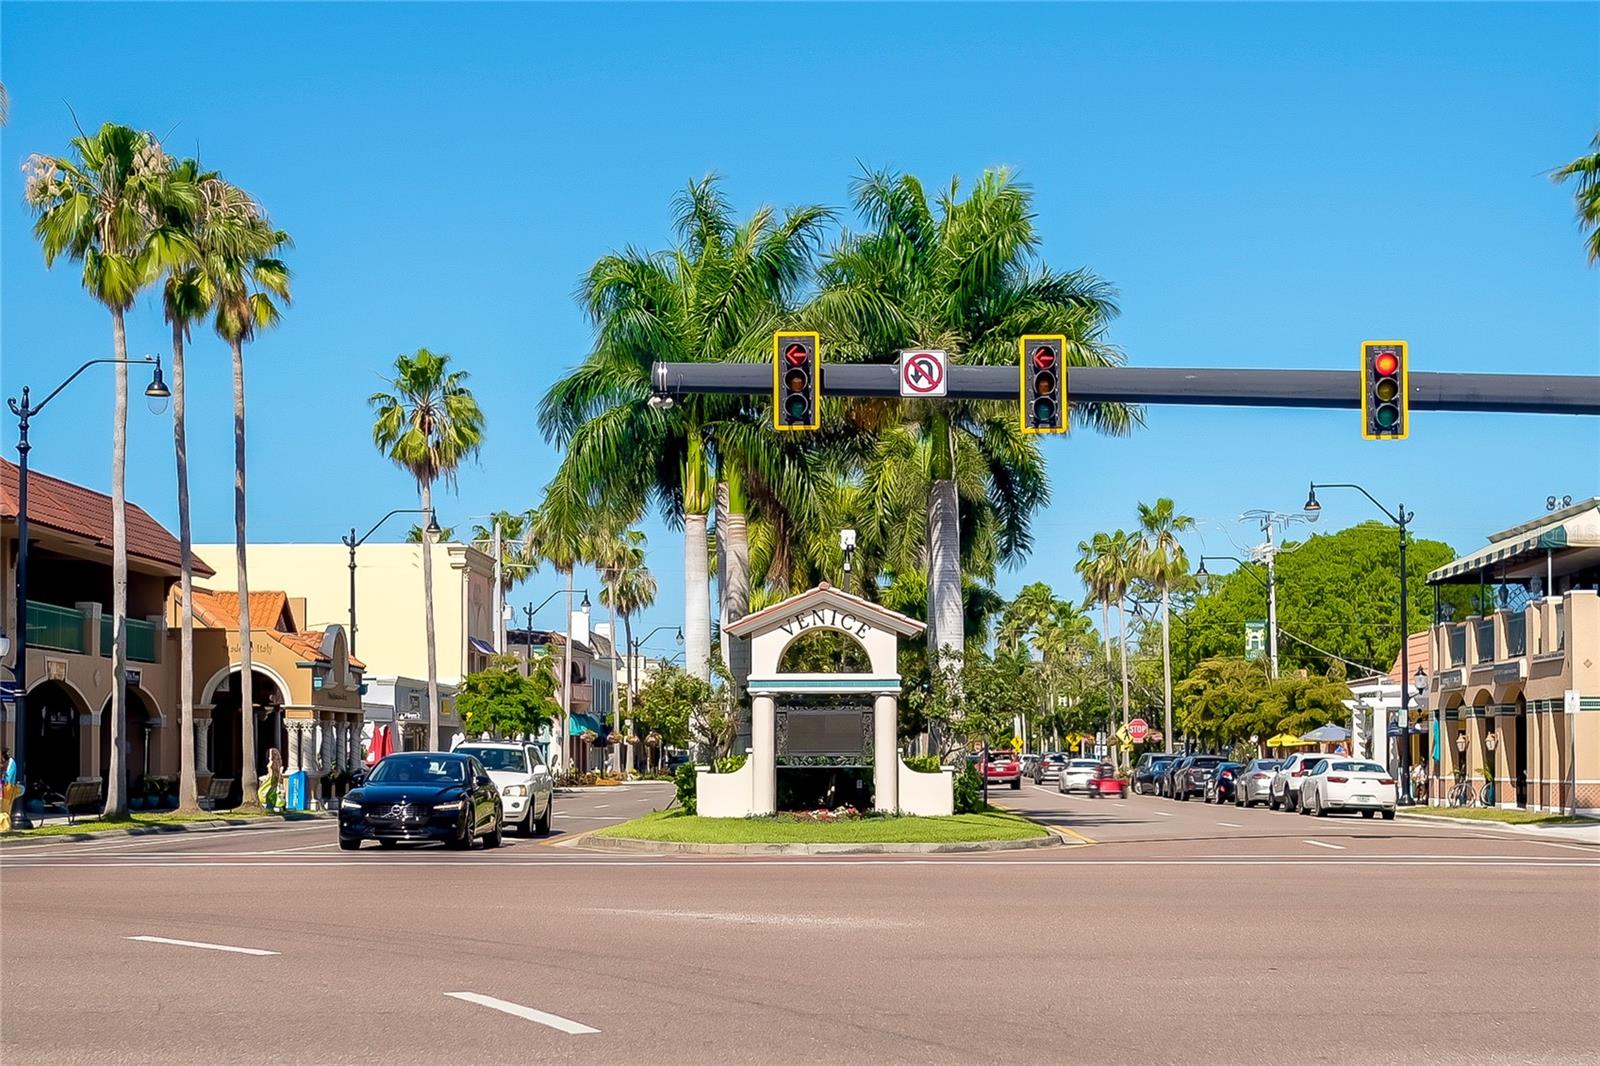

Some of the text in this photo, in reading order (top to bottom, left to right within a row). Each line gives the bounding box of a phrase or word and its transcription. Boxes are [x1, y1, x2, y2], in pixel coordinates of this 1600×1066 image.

[780, 609, 871, 639] VENICE
[257, 643, 273, 655] Italy
[1129, 725, 1147, 733] STOP
